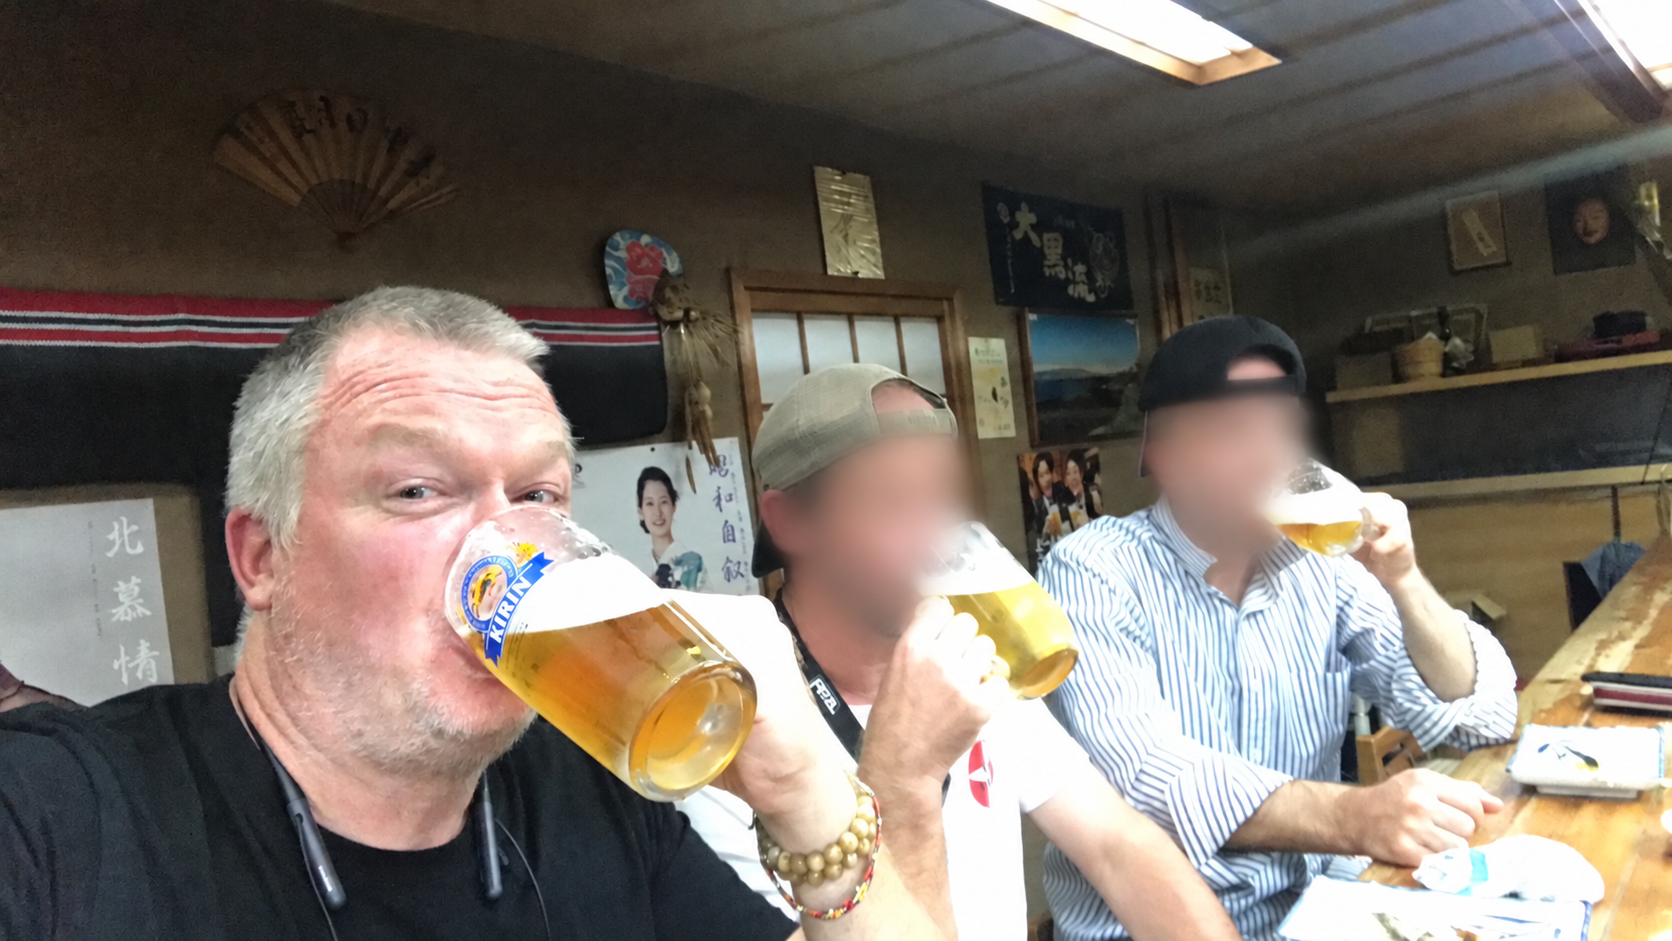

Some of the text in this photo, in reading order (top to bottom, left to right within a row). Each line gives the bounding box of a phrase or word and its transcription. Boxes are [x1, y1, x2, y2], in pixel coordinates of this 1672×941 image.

[105, 516, 160, 686] 北慕情
[489, 575, 533, 644] KIRIN
